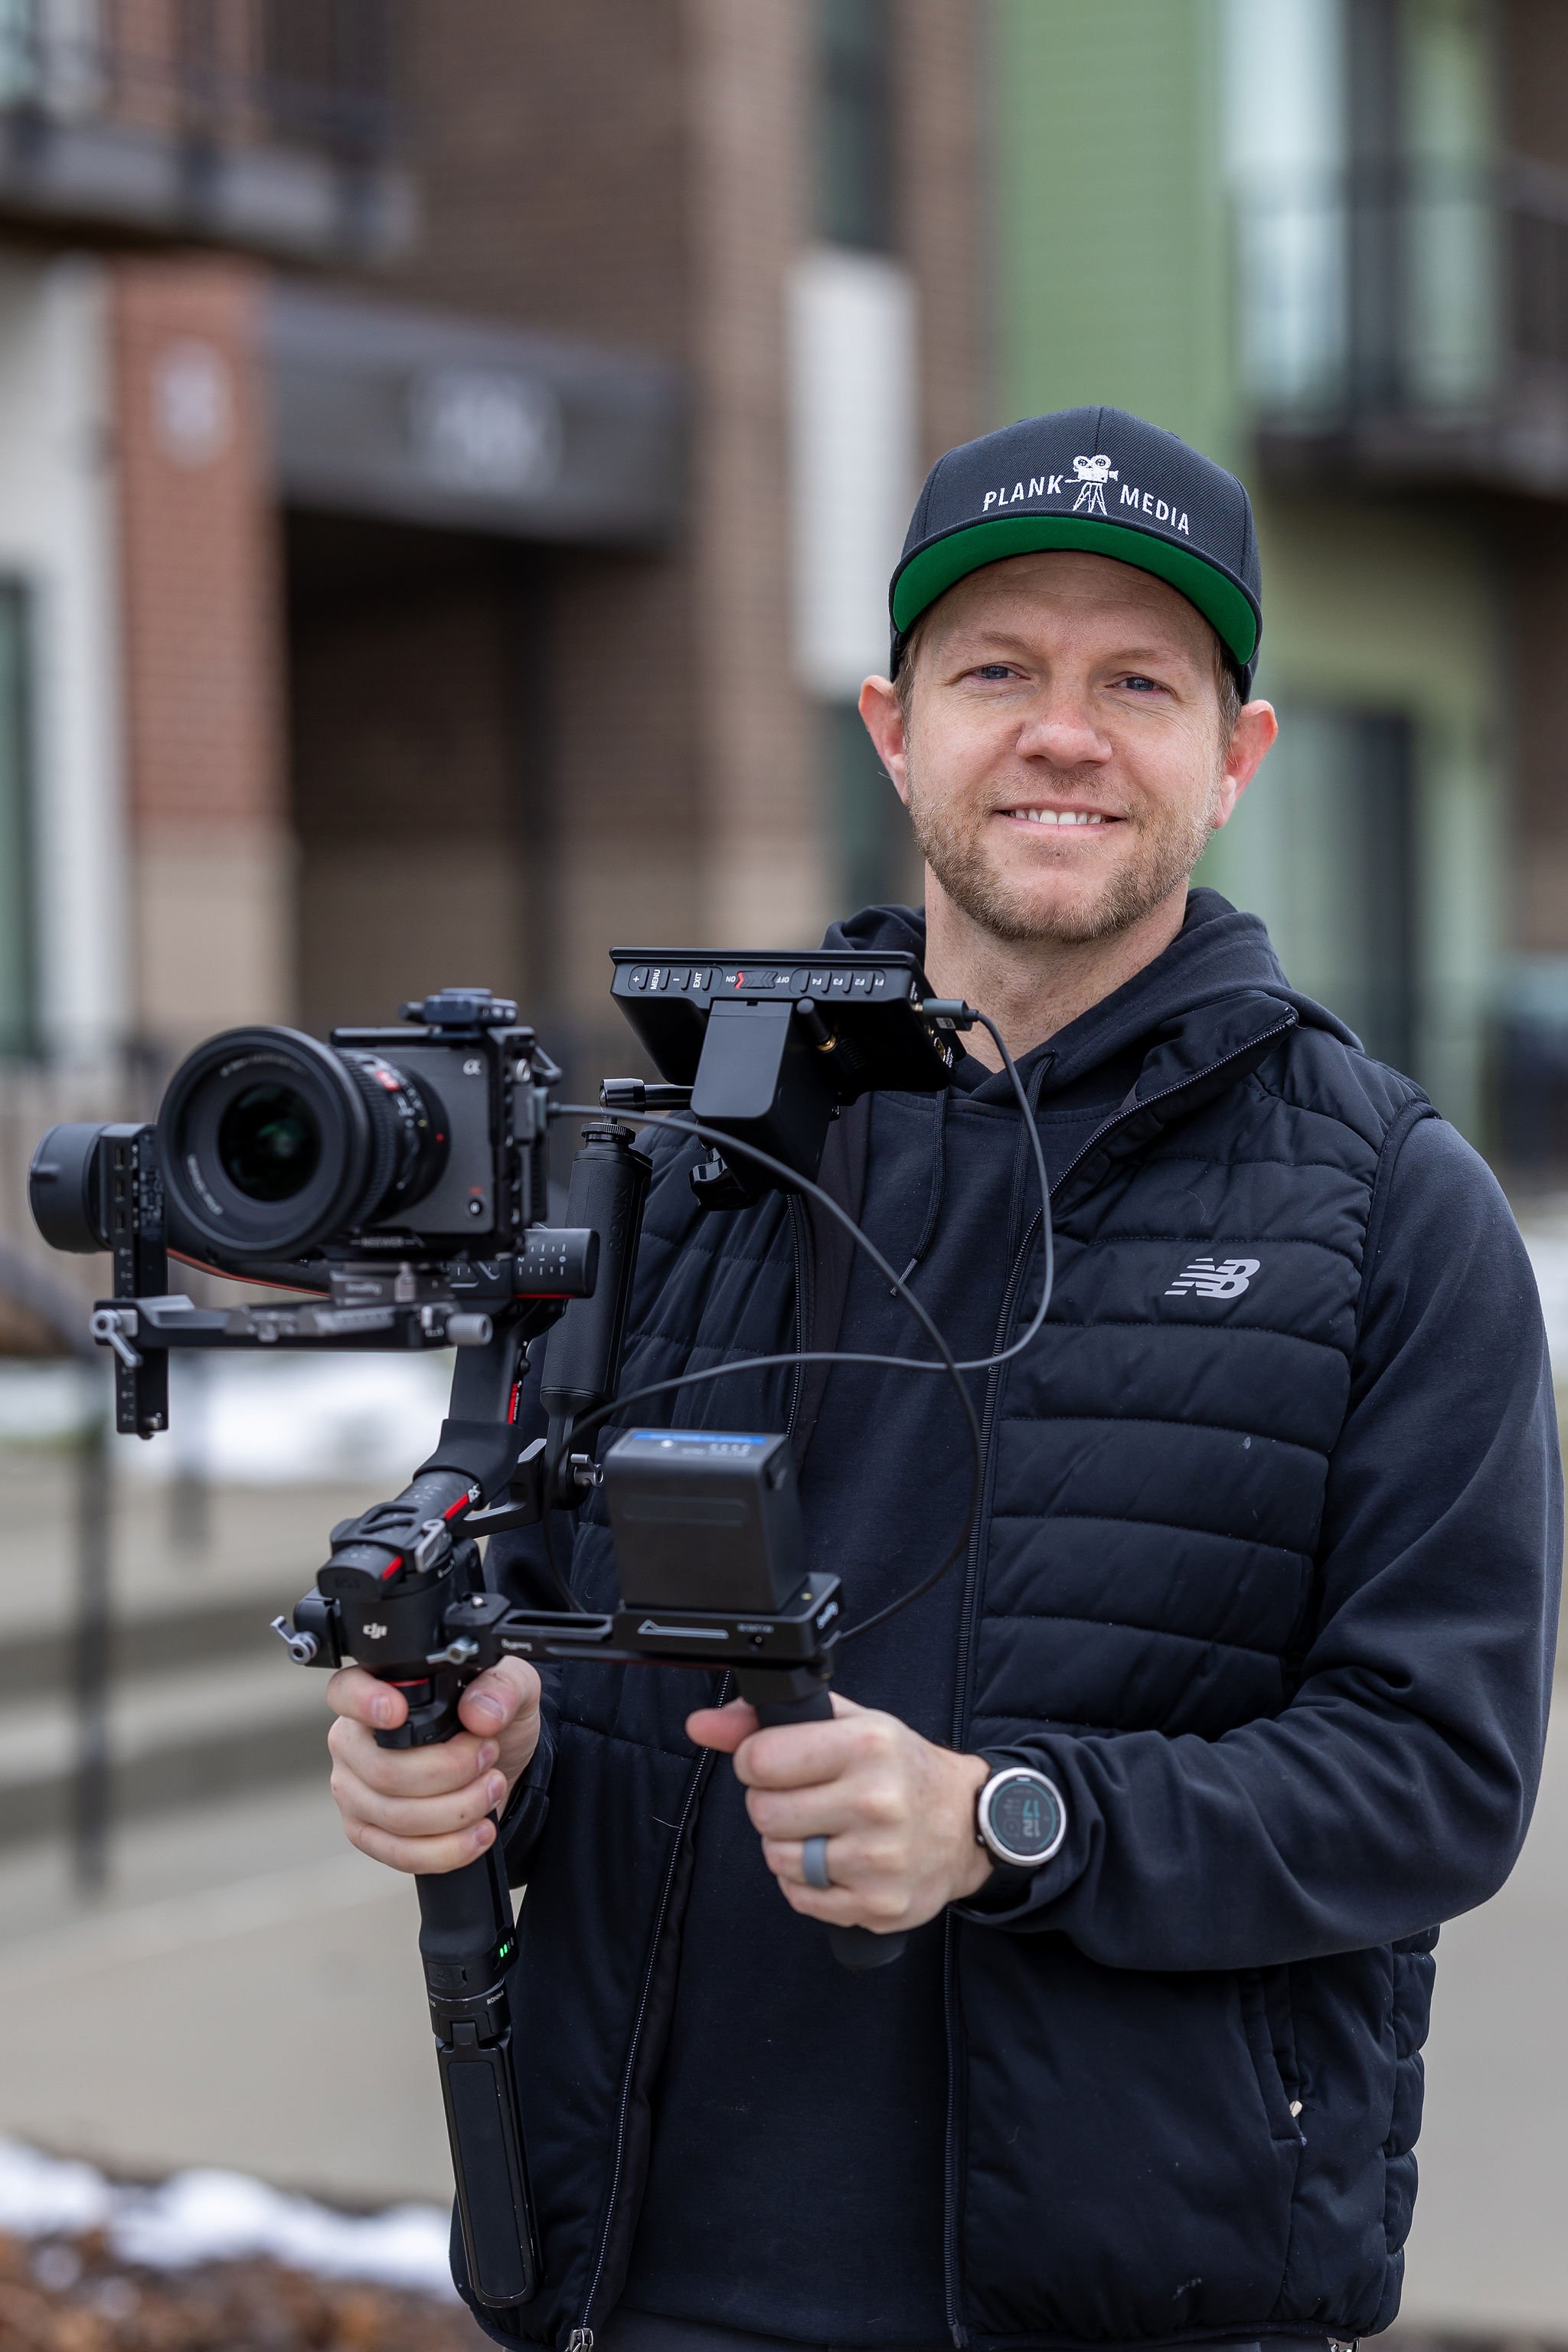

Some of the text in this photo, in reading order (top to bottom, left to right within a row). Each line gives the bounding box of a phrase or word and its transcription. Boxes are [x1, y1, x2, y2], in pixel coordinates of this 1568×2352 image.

[982, 475, 1190, 536] PLANK MEDIA
[650, 969, 661, 990] MENU
[692, 972, 703, 988] EXIT
[832, 978, 844, 986] F3
[854, 978, 865, 986] F2
